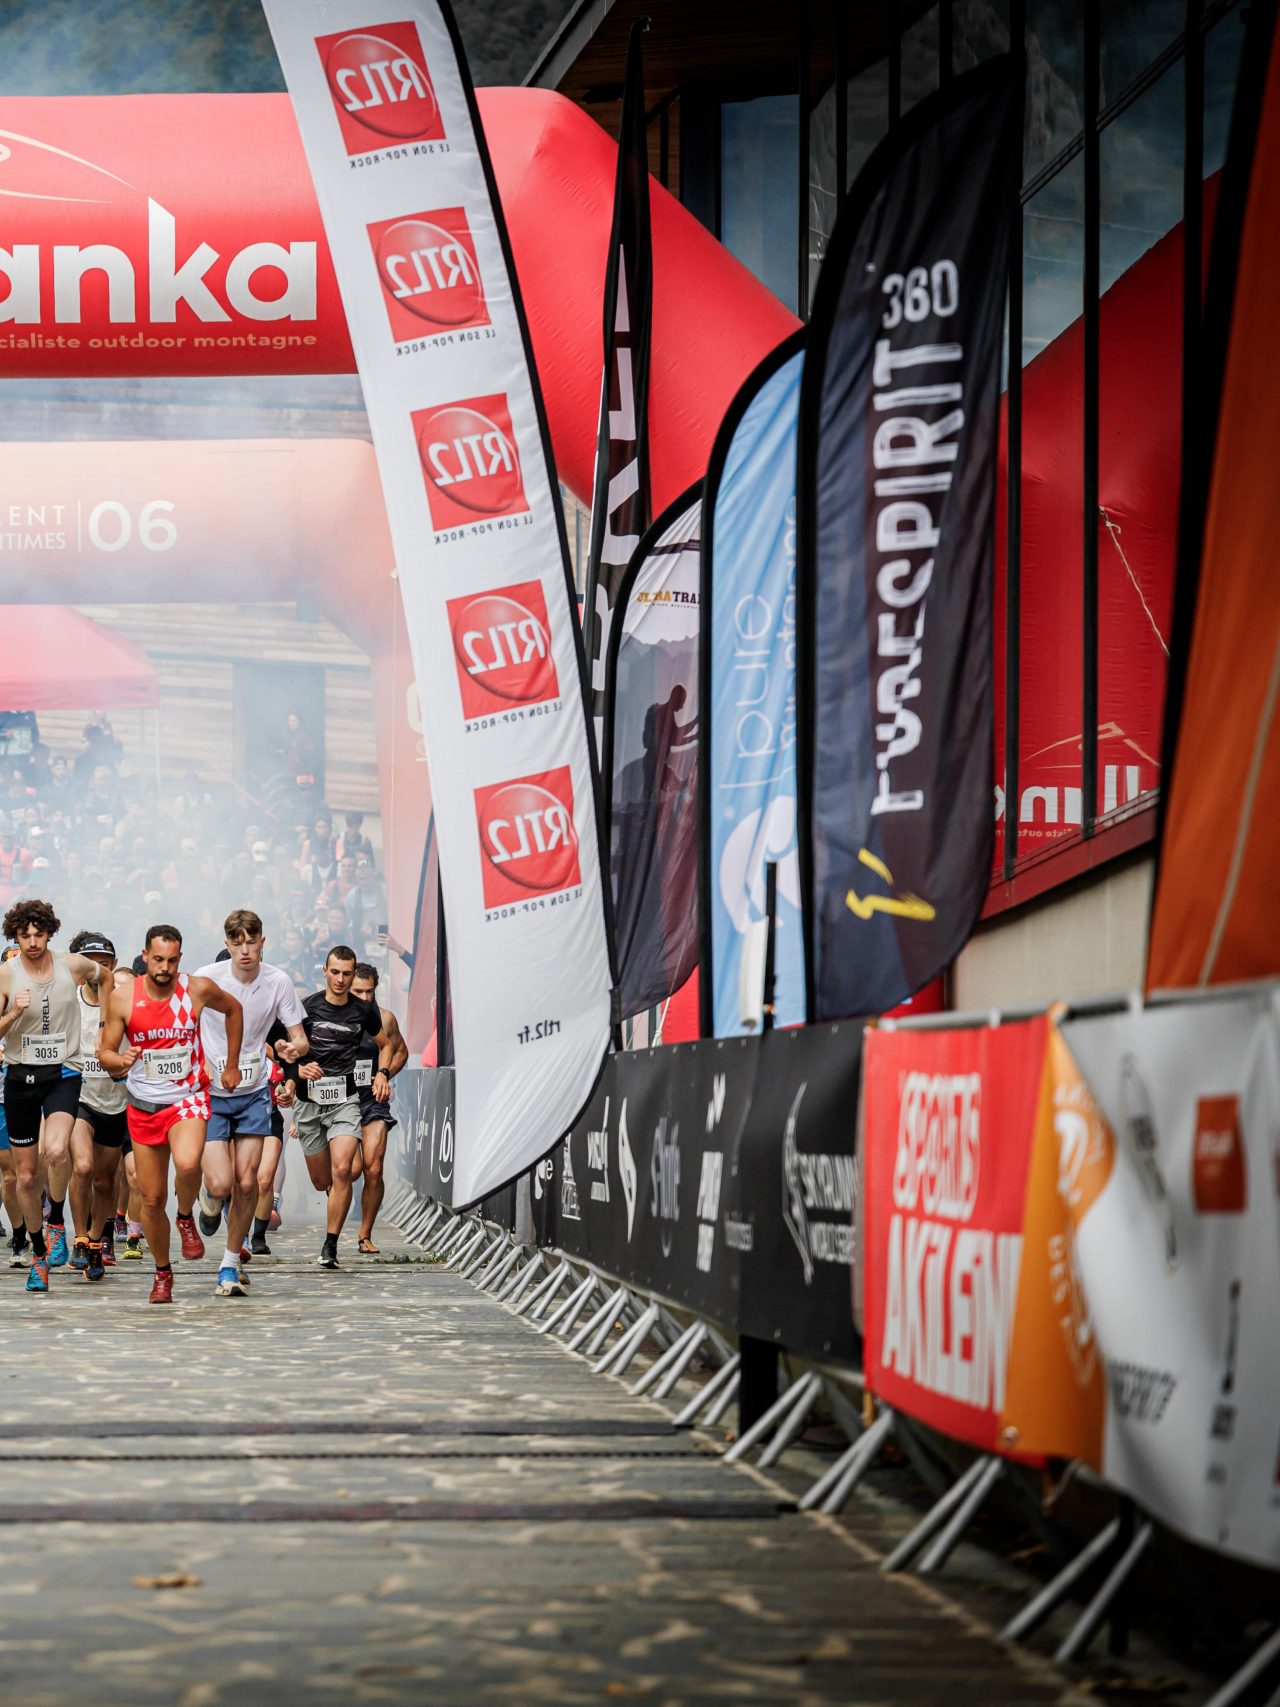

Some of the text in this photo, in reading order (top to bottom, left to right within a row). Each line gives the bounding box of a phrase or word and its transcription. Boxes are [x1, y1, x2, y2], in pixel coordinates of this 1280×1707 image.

[882, 258, 961, 329] 360
[88, 332, 187, 350] outdoor
[193, 332, 318, 352] montagne
[88, 499, 178, 553] 06
[734, 594, 776, 758] pure
[133, 1027, 193, 1042] AS MONACO
[34, 1047, 58, 1059] 3035
[85, 1061, 106, 1072] 309
[157, 1061, 183, 1075] 3208
[320, 1088, 339, 1100] 3016
